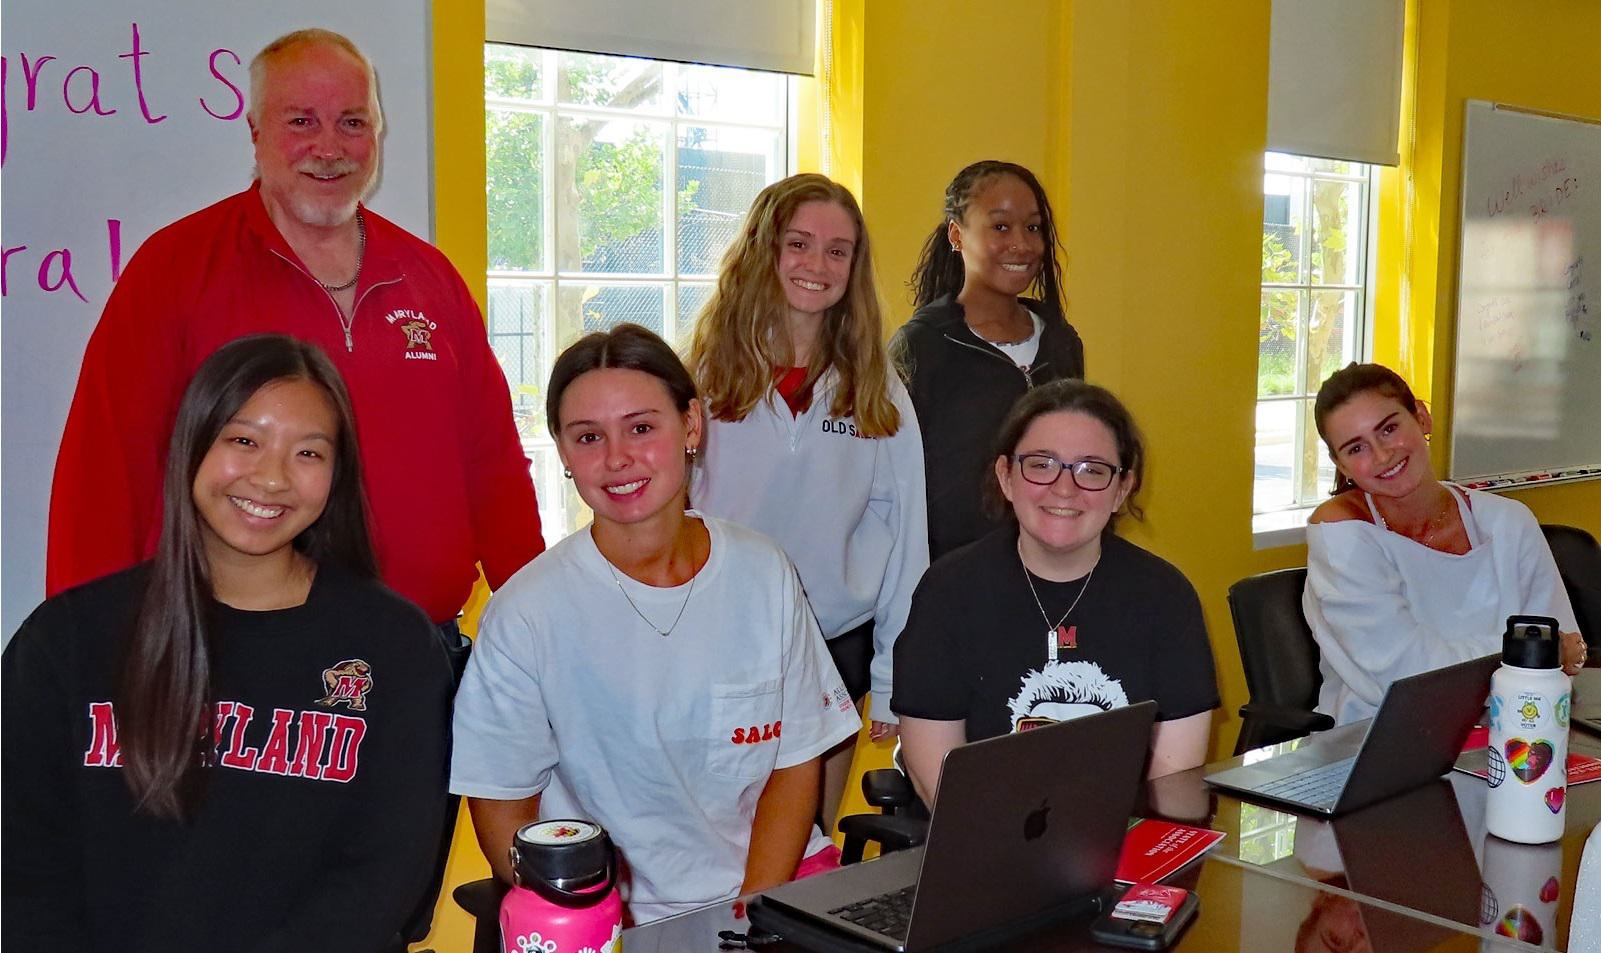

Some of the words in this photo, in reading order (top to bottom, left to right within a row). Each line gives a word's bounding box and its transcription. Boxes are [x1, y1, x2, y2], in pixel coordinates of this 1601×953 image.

[385, 309, 437, 330] MARYLAND
[405, 351, 437, 361] ALUMNI
[822, 420, 846, 434] OLD
[1057, 625, 1078, 648] M
[332, 675, 367, 698] M
[84, 701, 367, 783] MYLAND
